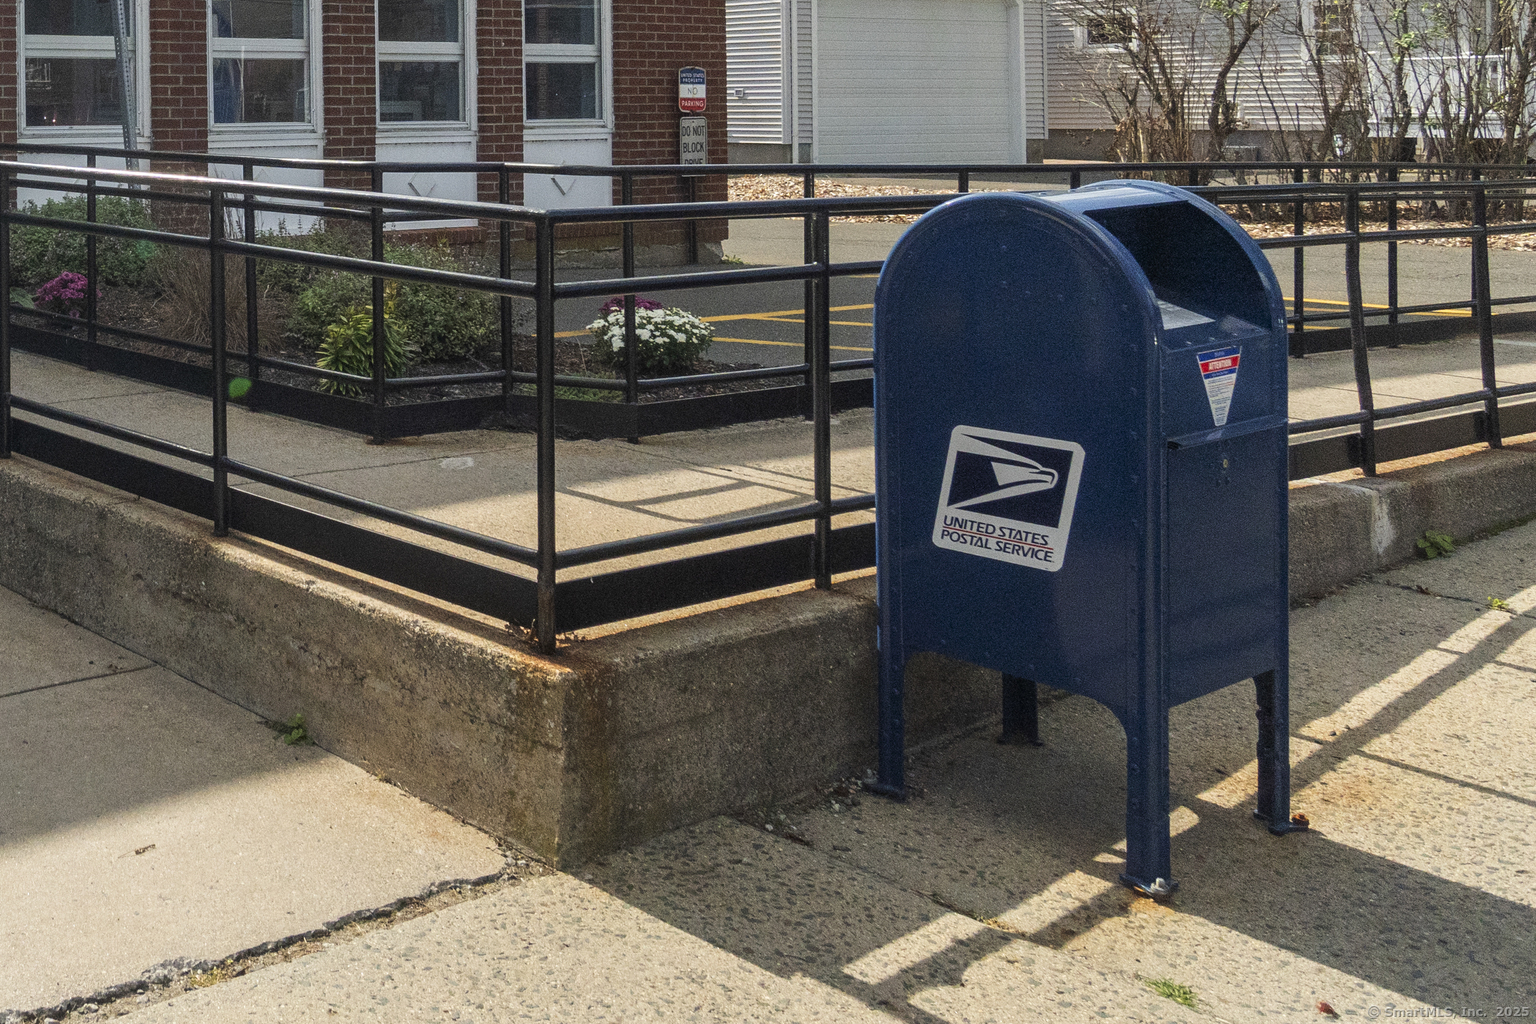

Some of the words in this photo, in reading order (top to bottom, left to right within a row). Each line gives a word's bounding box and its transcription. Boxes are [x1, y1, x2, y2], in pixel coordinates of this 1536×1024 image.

[687, 87, 698, 95] NO
[681, 126, 691, 136] DO
[692, 125, 705, 136] NOT
[683, 142, 704, 153] BLOCK
[943, 515, 996, 535] UNITED
[998, 526, 1049, 546] STATES
[940, 529, 992, 549] POSTAL
[994, 540, 1054, 563] SERVICE
